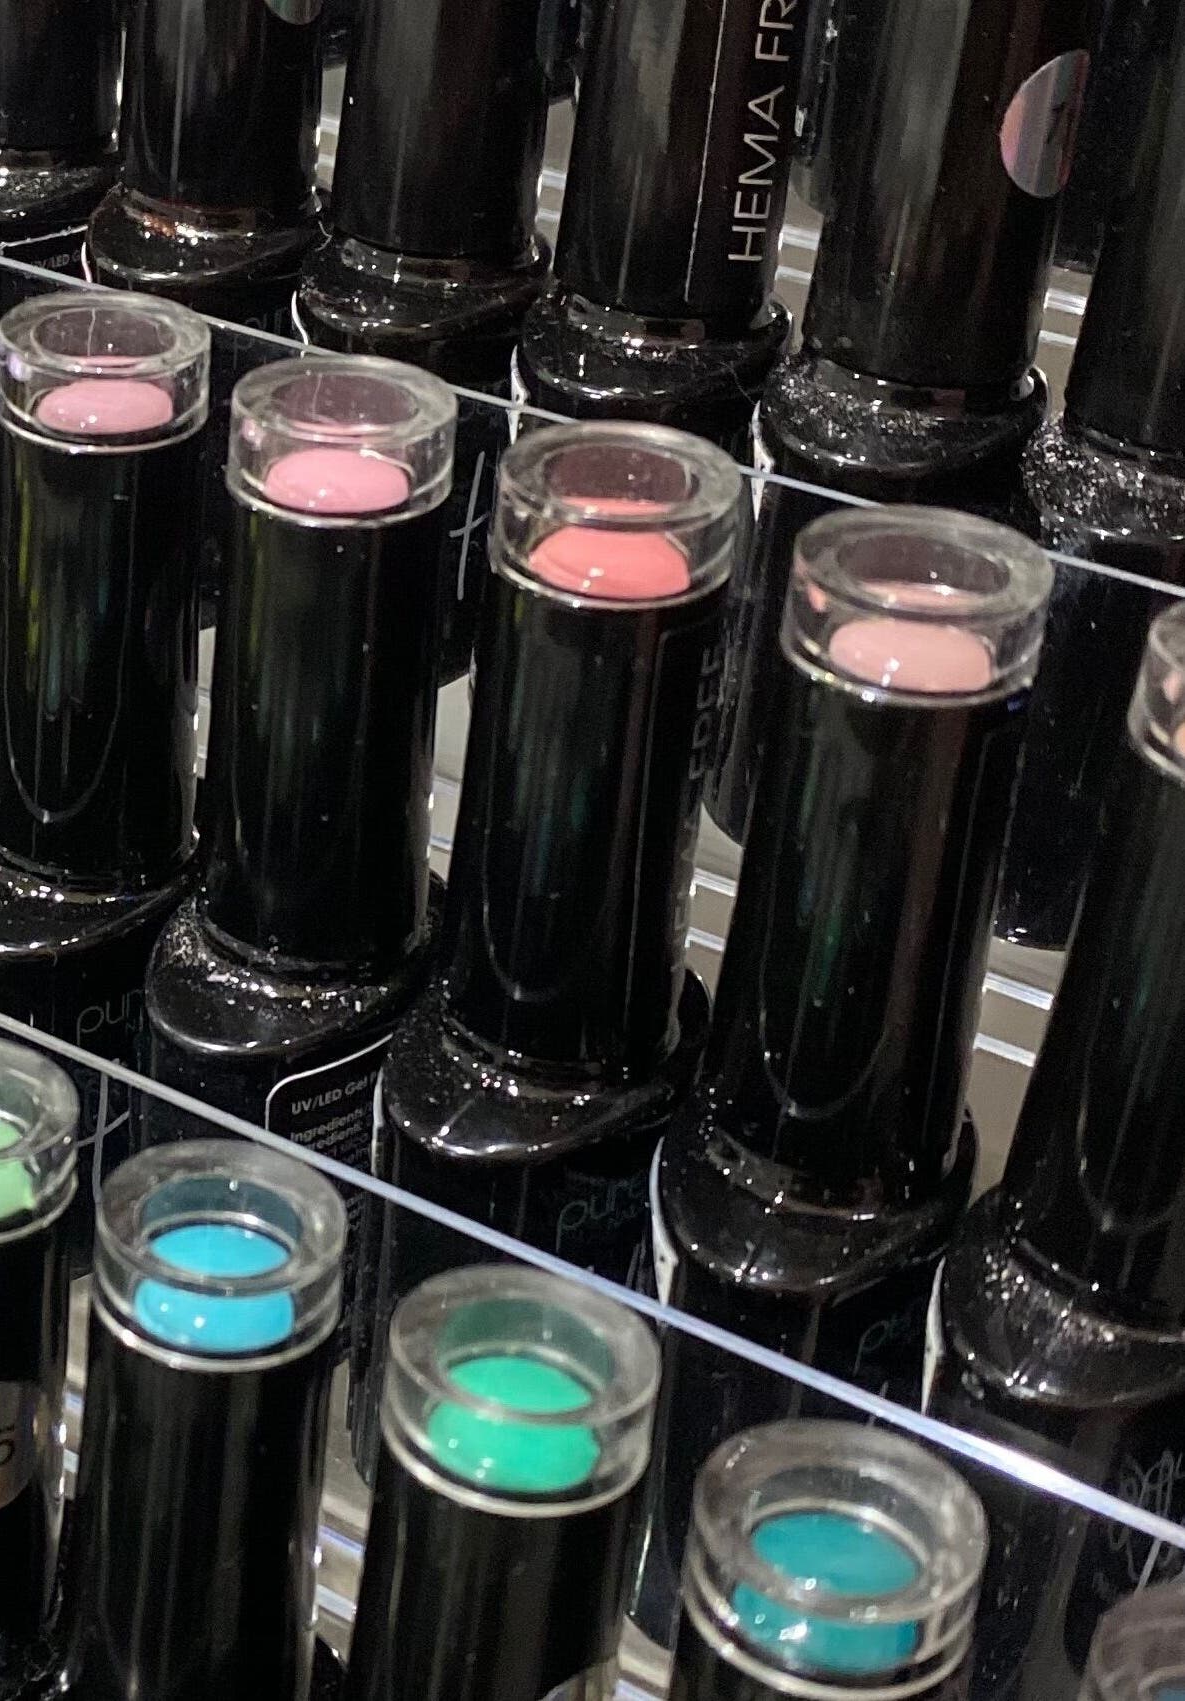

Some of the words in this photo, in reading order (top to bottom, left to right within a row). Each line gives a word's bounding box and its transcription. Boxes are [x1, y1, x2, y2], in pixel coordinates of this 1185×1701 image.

[753, 0, 798, 62] FR
[727, 85, 786, 261] HEMA
[75, 988, 144, 1046] pur
[291, 1088, 343, 1116] UV/LED
